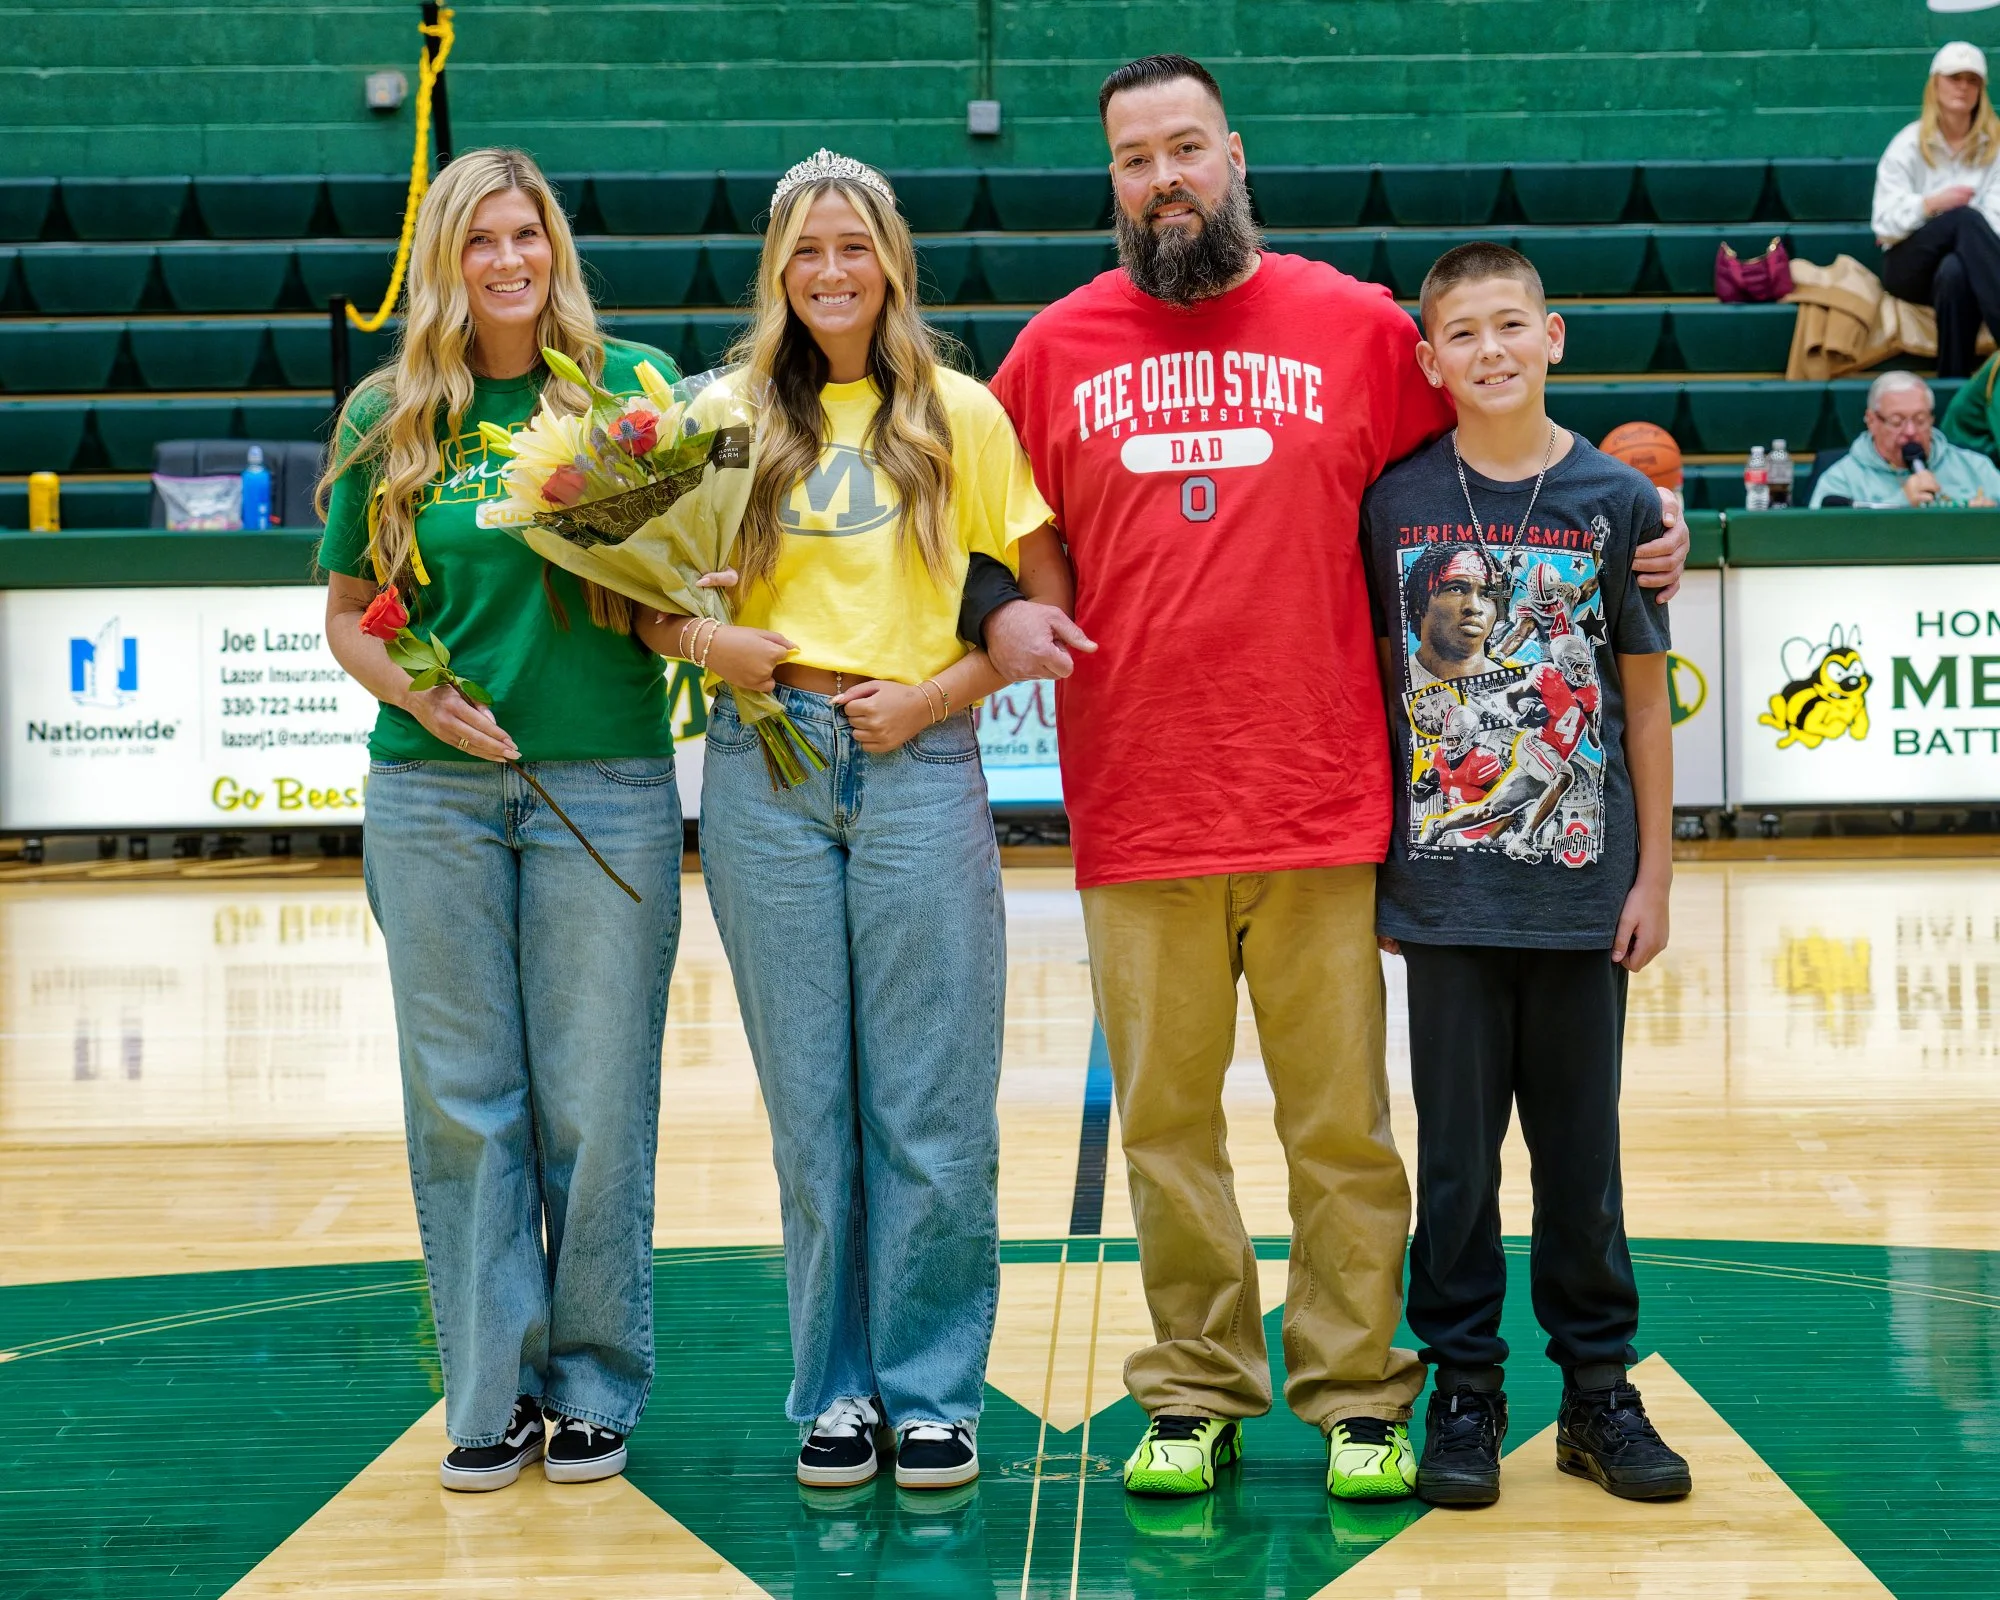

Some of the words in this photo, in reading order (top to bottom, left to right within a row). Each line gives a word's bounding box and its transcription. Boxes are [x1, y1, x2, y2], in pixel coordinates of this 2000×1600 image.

[1074, 363, 1133, 442] THE
[1141, 350, 1215, 412] OHIO
[1223, 351, 1323, 424] STATE
[1171, 437, 1223, 464] DAD
[1180, 475, 1217, 522] O
[1527, 526, 1595, 549] SMITH
[220, 628, 256, 652] Joe
[264, 628, 321, 651] Lazor
[221, 667, 263, 683] Lazor
[269, 667, 346, 682] Insurance
[222, 697, 338, 715] 330-722-4444
[27, 721, 175, 741] Nationwide
[1555, 706, 1581, 744] 4
[212, 776, 264, 811] Go
